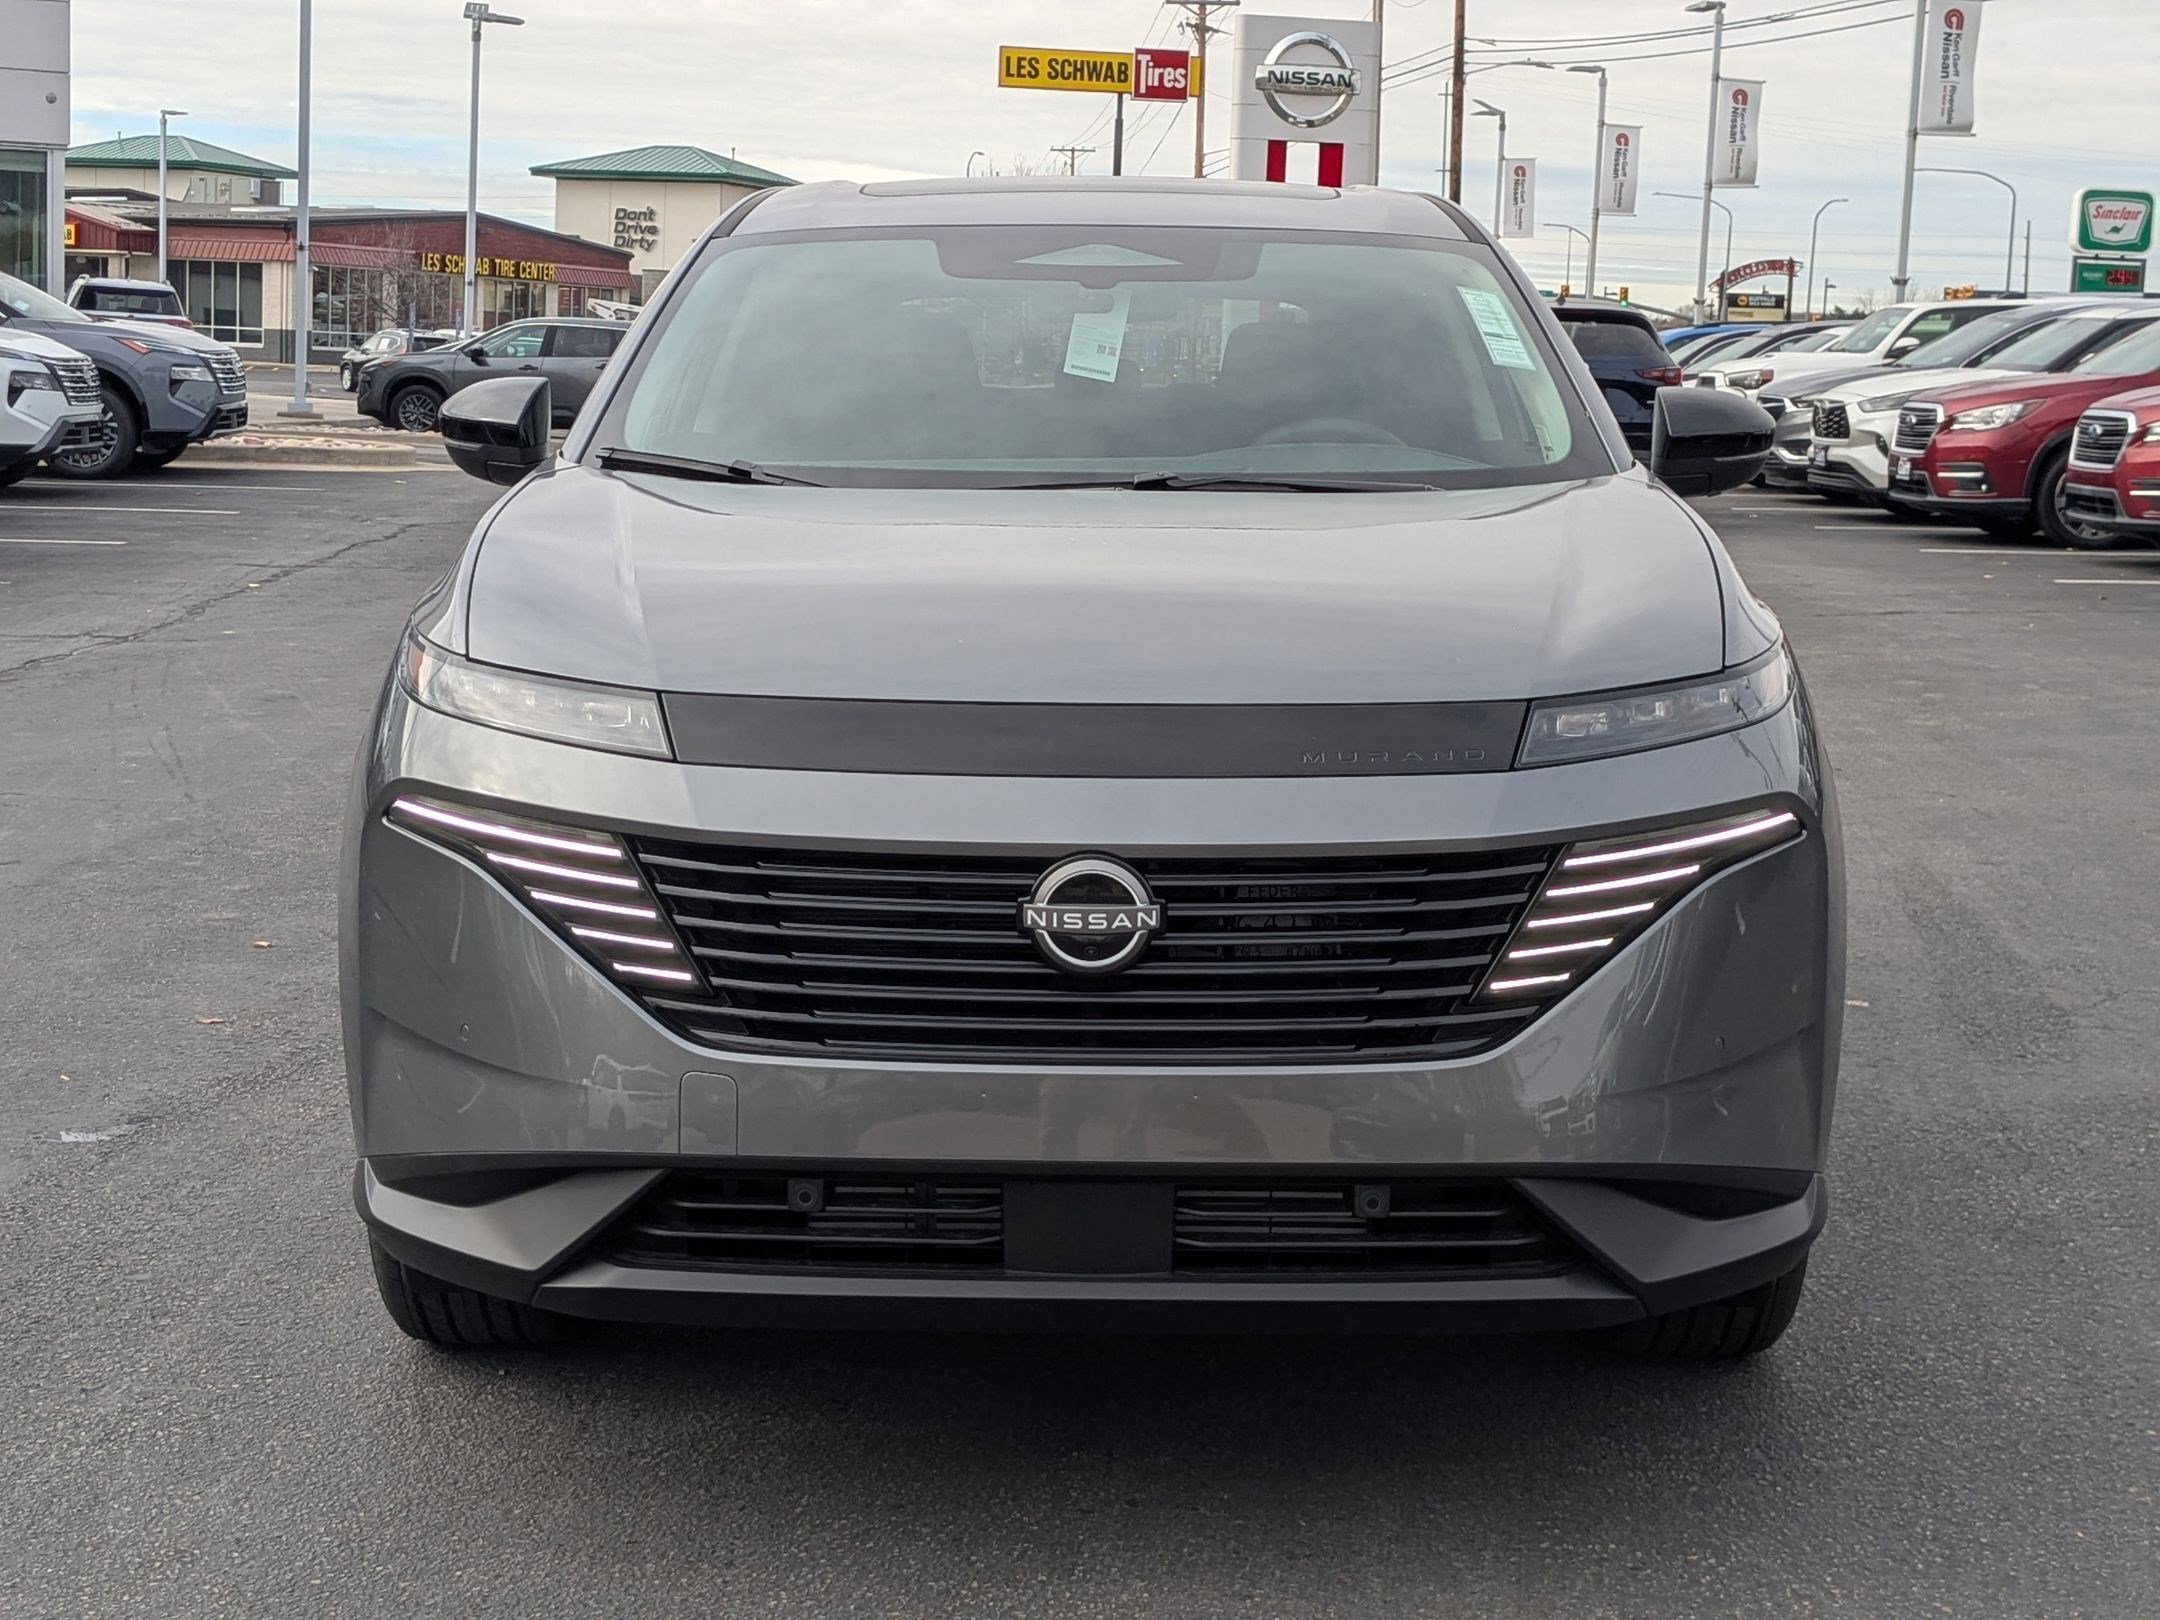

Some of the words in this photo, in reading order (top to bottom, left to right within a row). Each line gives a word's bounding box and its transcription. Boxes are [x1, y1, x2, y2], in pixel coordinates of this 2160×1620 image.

[1940, 31, 1954, 79] Nissan
[1005, 56, 1040, 79] LES
[1047, 58, 1129, 83] SCHWAB
[1137, 54, 1187, 94] Tires
[1267, 70, 1353, 88] NISSAN
[1728, 106, 1740, 144] Nissan
[614, 206, 656, 221] Don't
[2092, 204, 2143, 221] Sinclair
[614, 221, 659, 235] Drive
[613, 234, 657, 253] Dirty
[421, 253, 440, 272] LES
[445, 254, 490, 275] SCHAB
[495, 258, 515, 277] TIRE
[520, 261, 555, 281] CENTER
[1302, 747, 1486, 764] MURANO
[1026, 909, 1158, 930] NISSAN
